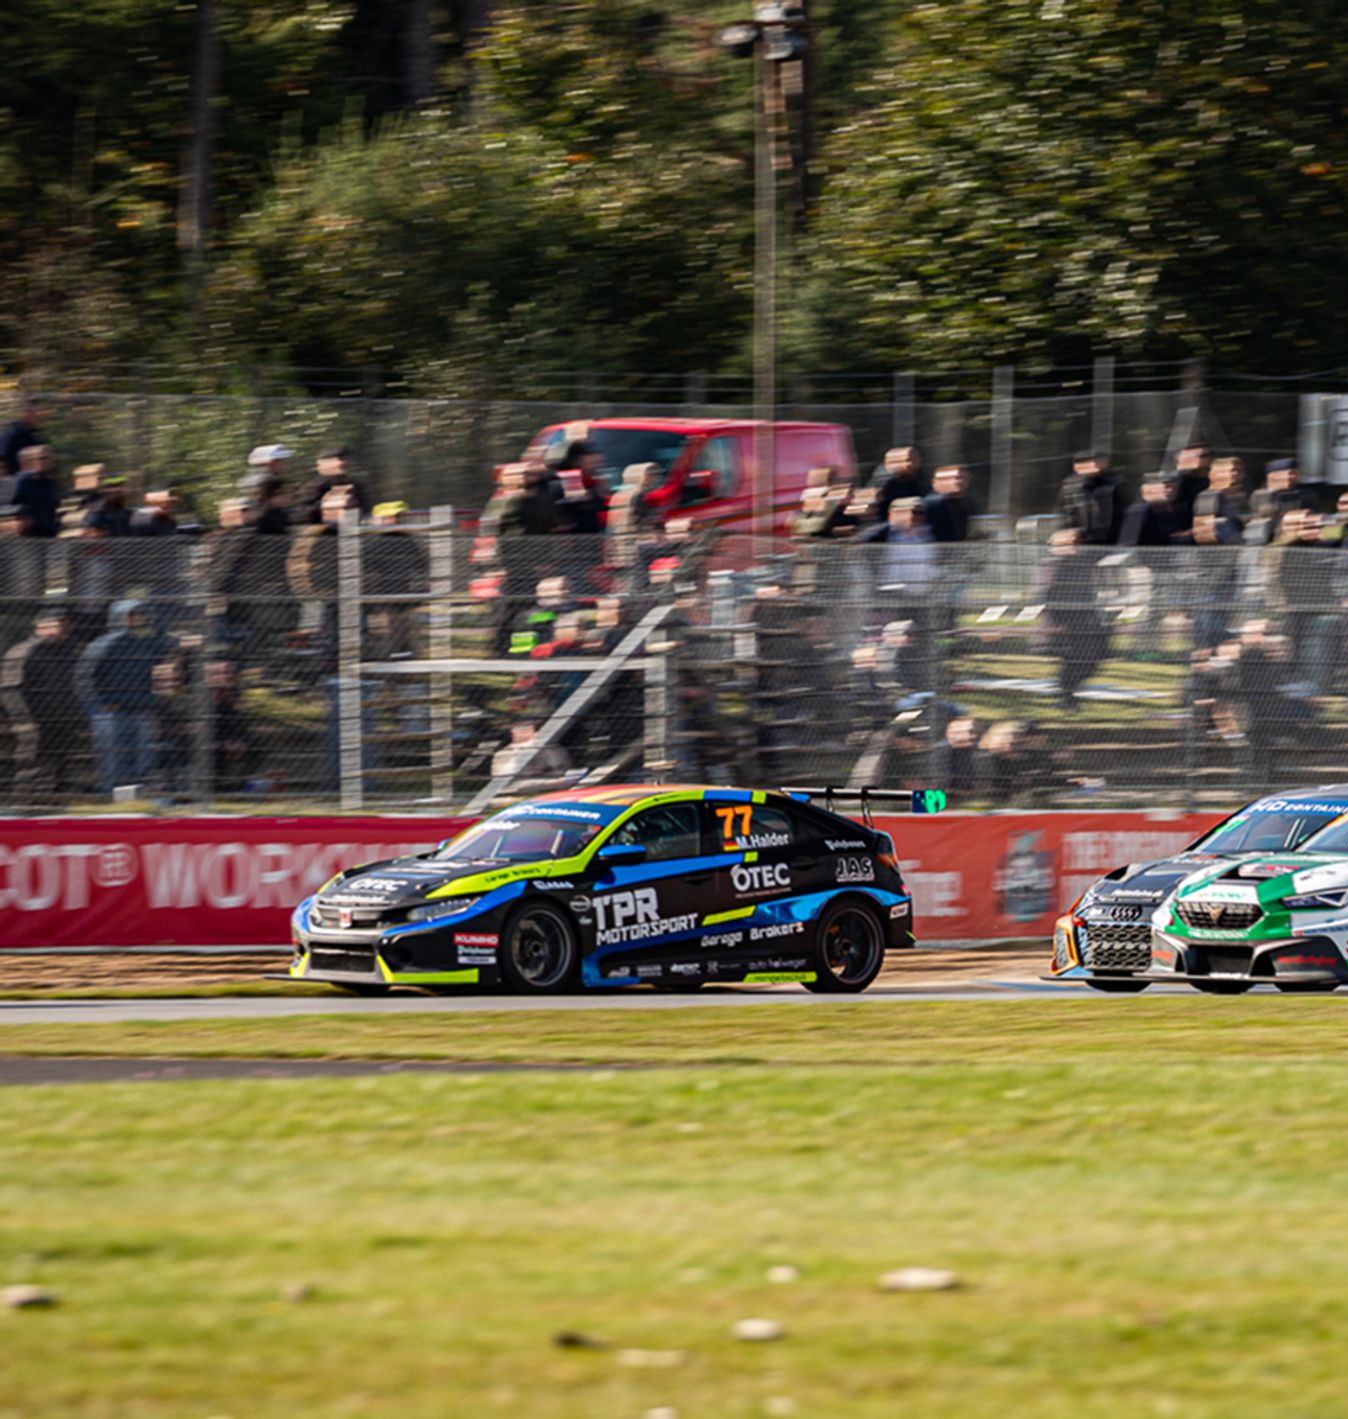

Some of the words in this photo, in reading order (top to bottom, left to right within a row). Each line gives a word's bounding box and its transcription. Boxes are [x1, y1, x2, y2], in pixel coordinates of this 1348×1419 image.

[715, 804, 753, 839] 77
[730, 862, 792, 892] OTEC
[592, 887, 660, 931] TPR
[596, 912, 699, 947] MOTORSPORT
